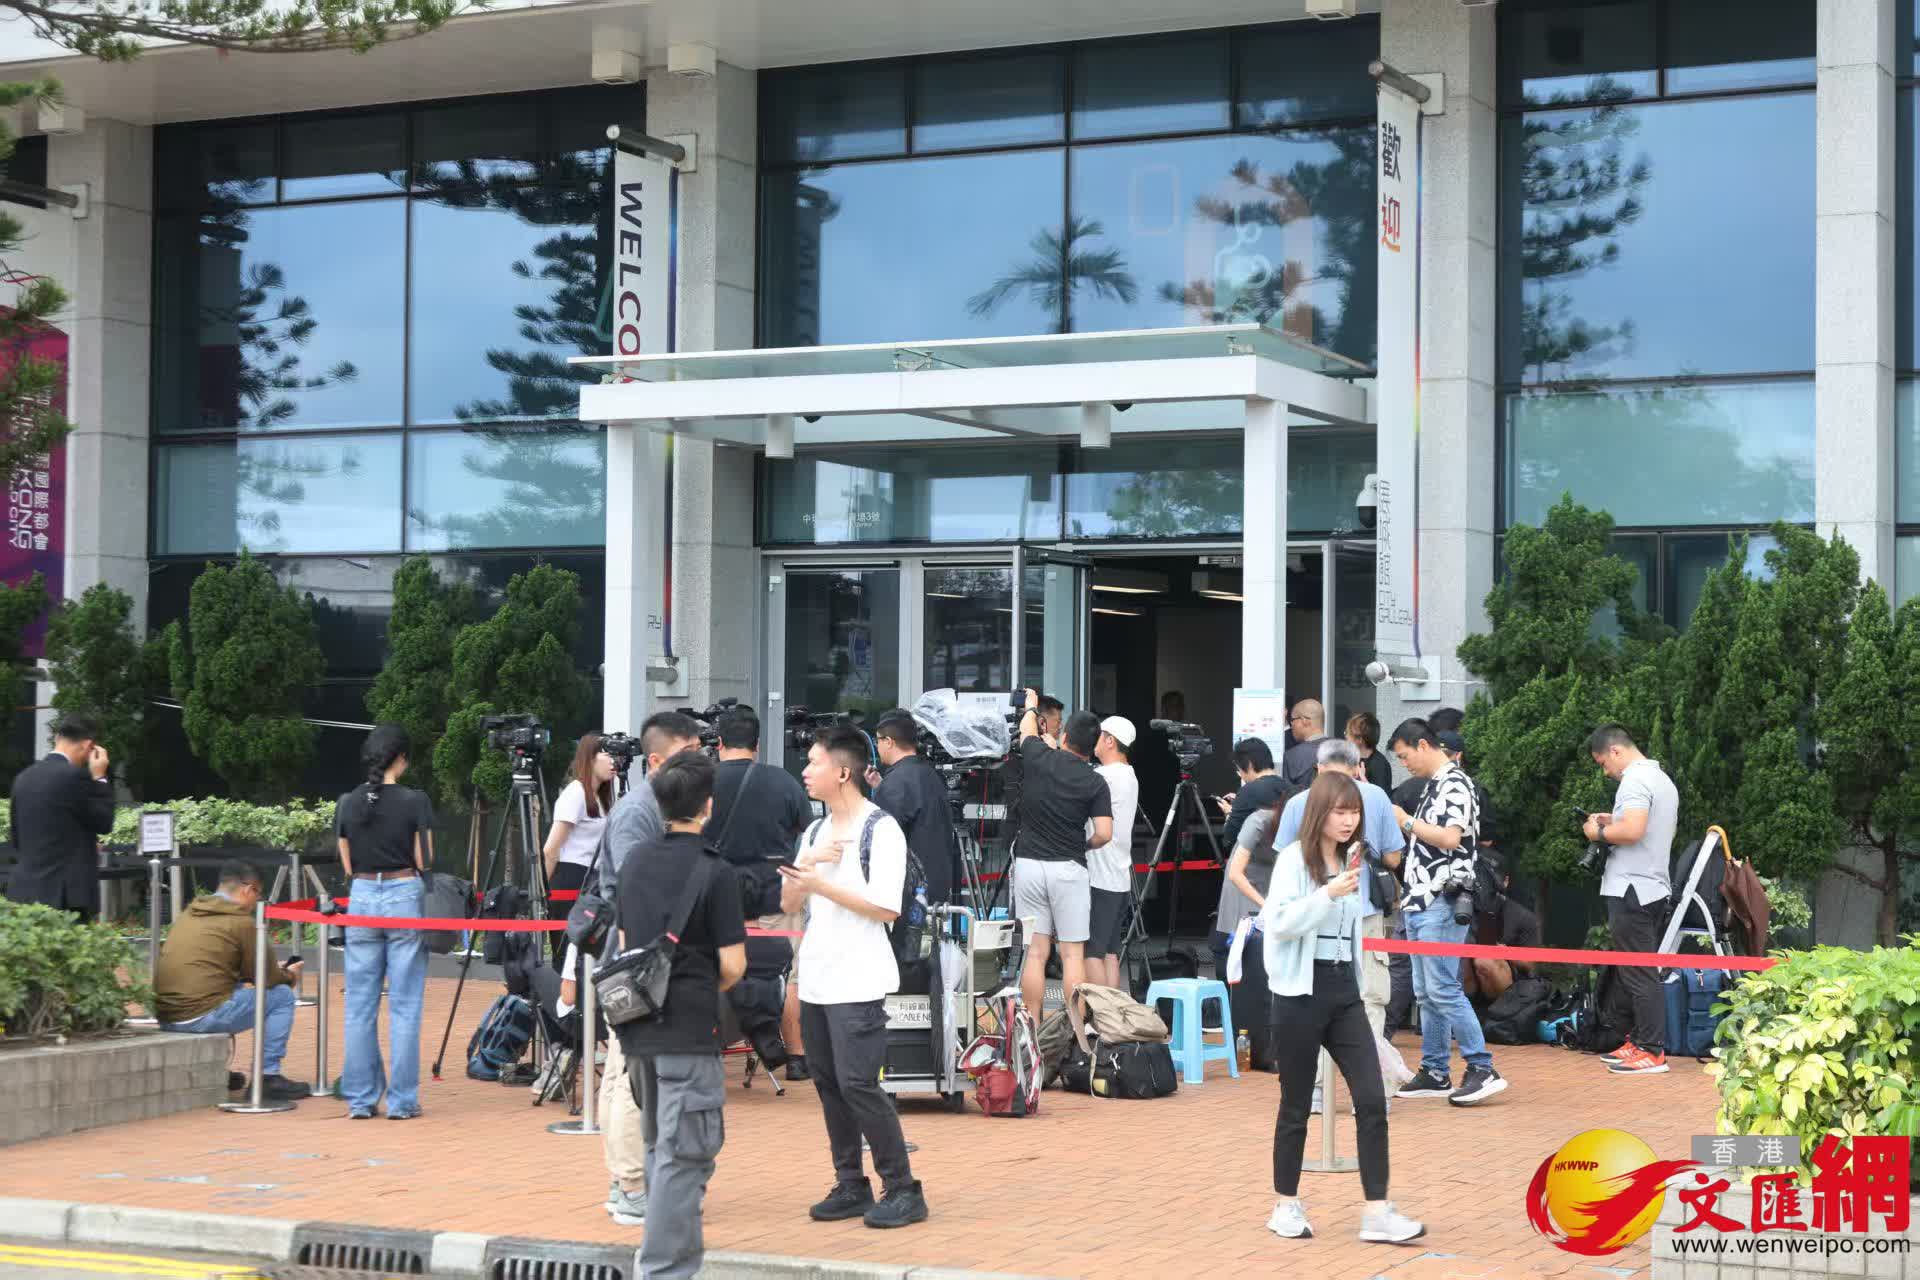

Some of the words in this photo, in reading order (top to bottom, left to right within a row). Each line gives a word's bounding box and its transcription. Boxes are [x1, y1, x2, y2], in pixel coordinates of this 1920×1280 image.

[1381, 121, 1402, 252] 歡迎
[609, 182, 643, 381] WELCO
[8, 506, 20, 548] CITY
[18, 468, 34, 549] KONG
